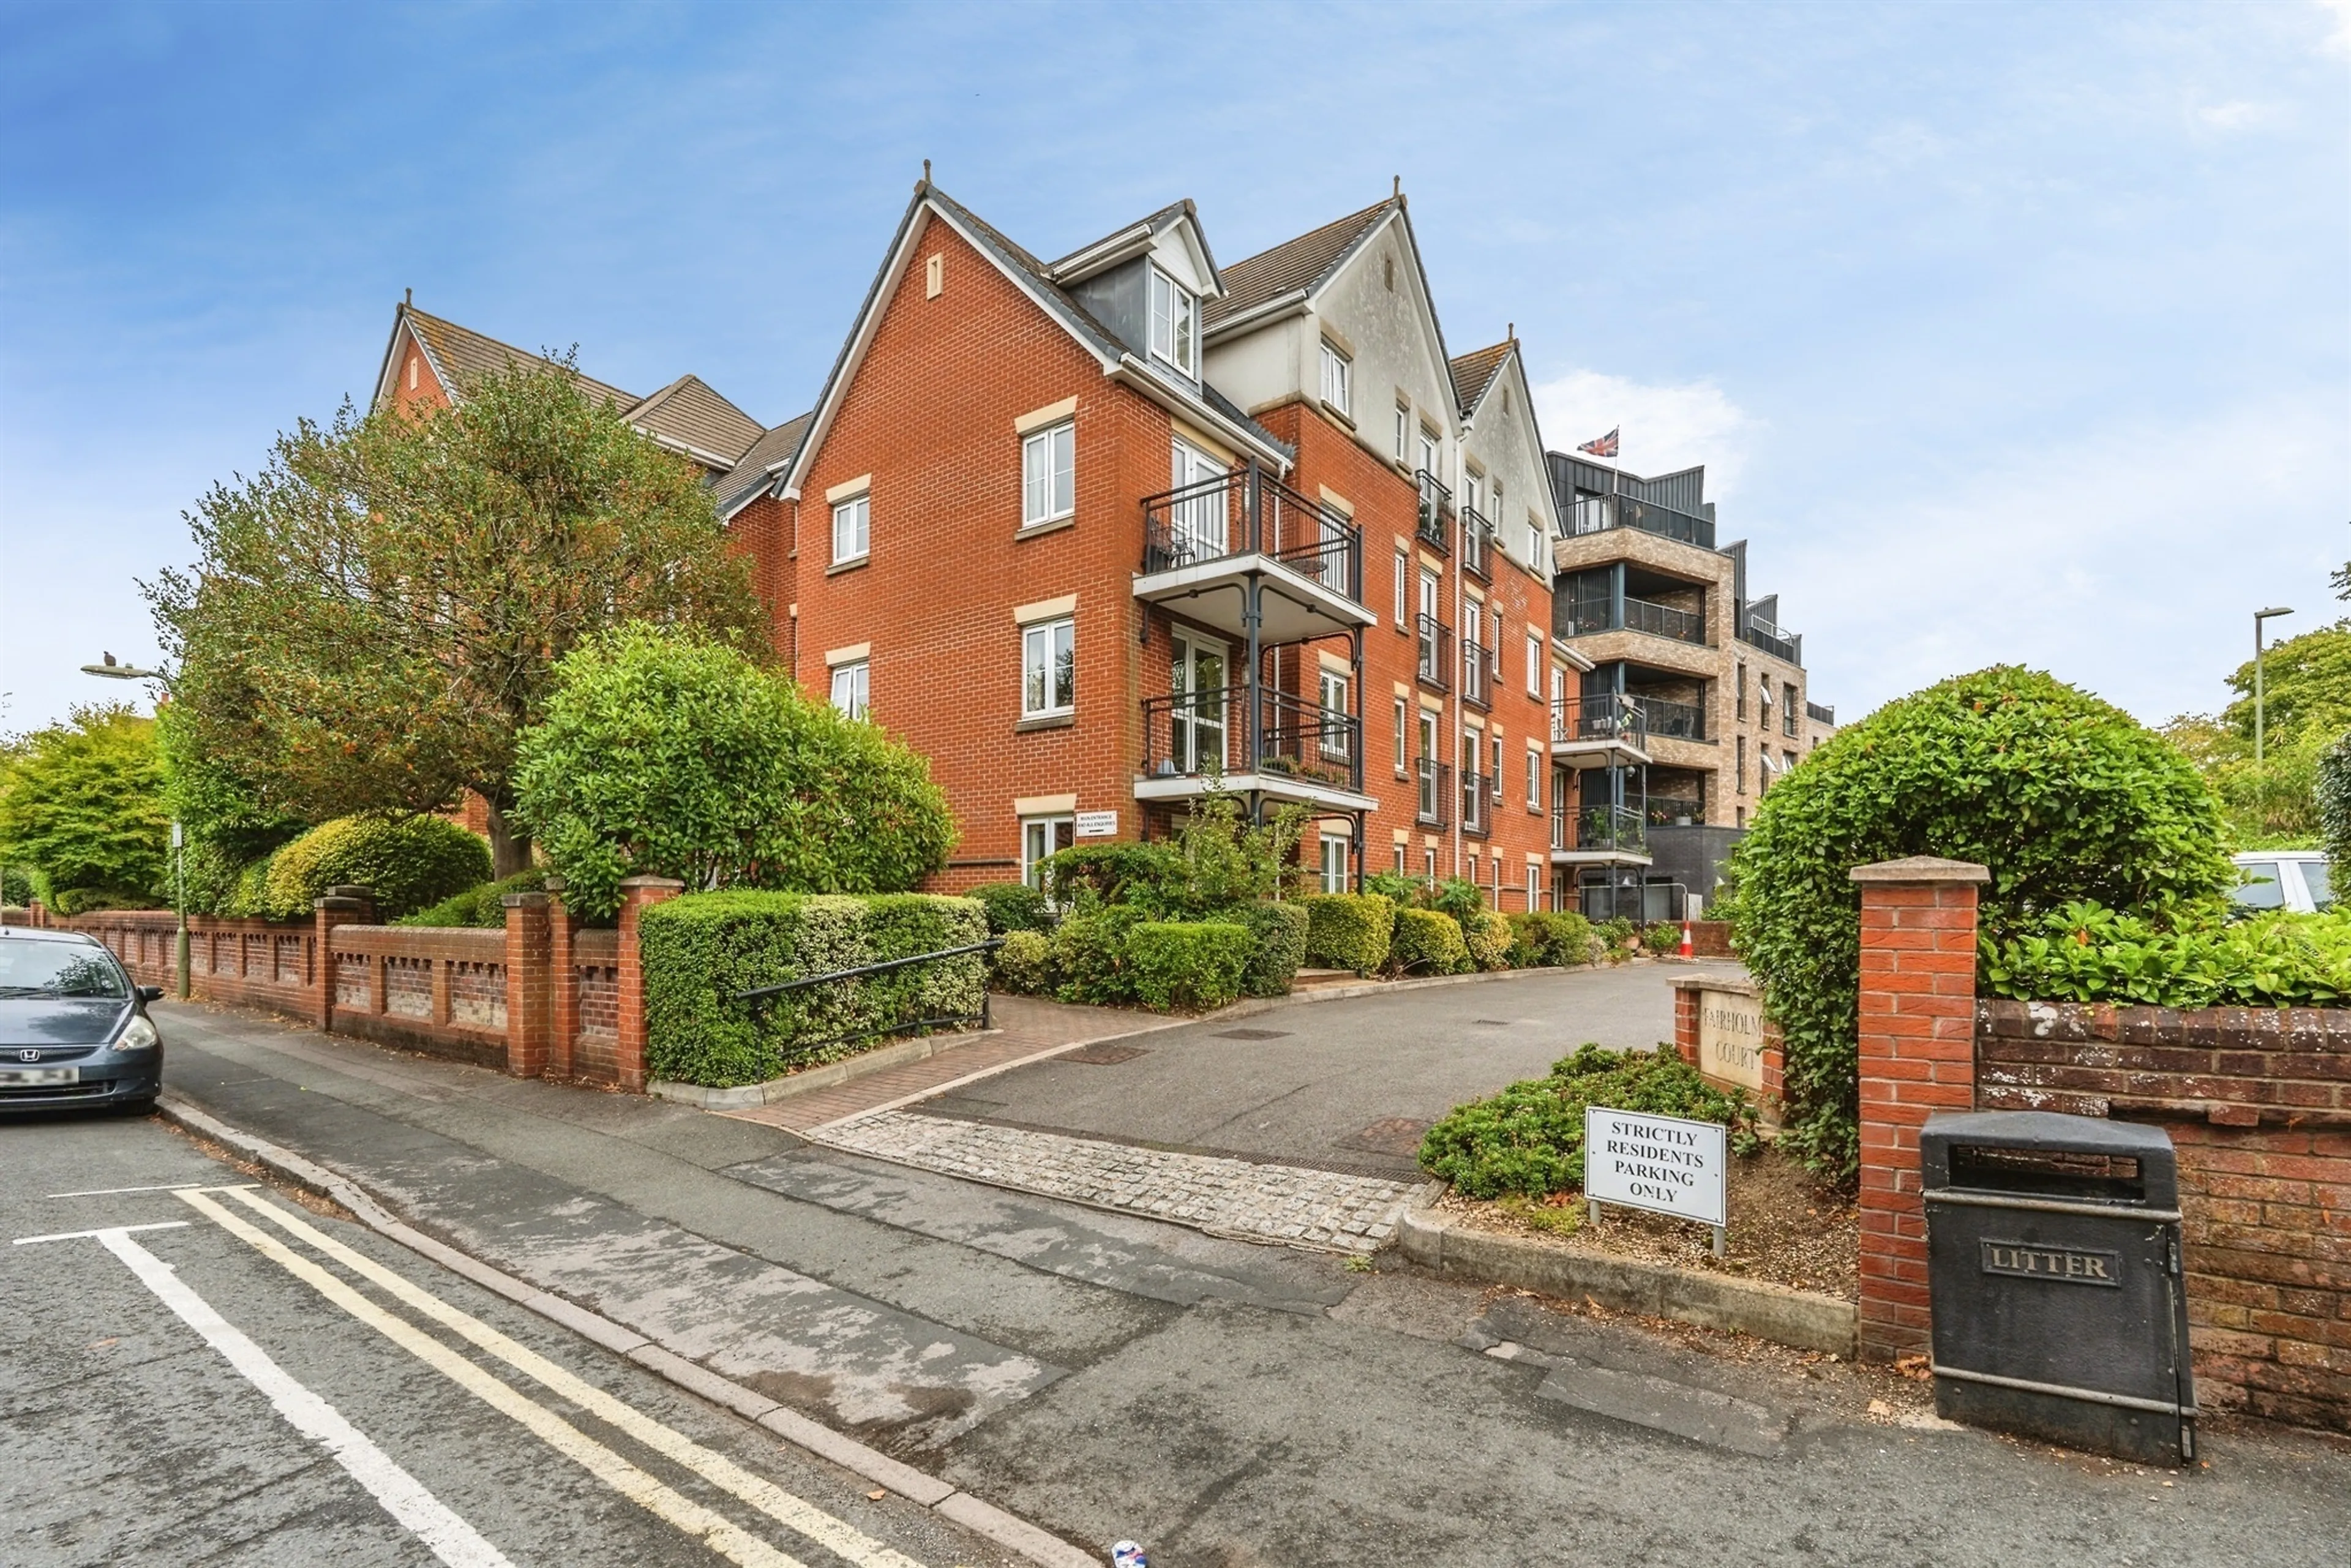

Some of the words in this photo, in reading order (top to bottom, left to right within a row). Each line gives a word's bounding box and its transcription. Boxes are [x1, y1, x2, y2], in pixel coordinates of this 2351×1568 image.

[1704, 1008, 1763, 1038] FAIRHOLM
[1715, 1041, 1754, 1070] COURT
[1611, 1122, 1698, 1146] STRICTLY
[1607, 1140, 1704, 1168] RESIDENTS
[1614, 1160, 1694, 1187] PARKING
[1630, 1182, 1678, 1202] ONLY
[1990, 1248, 2108, 1278] LITTER
